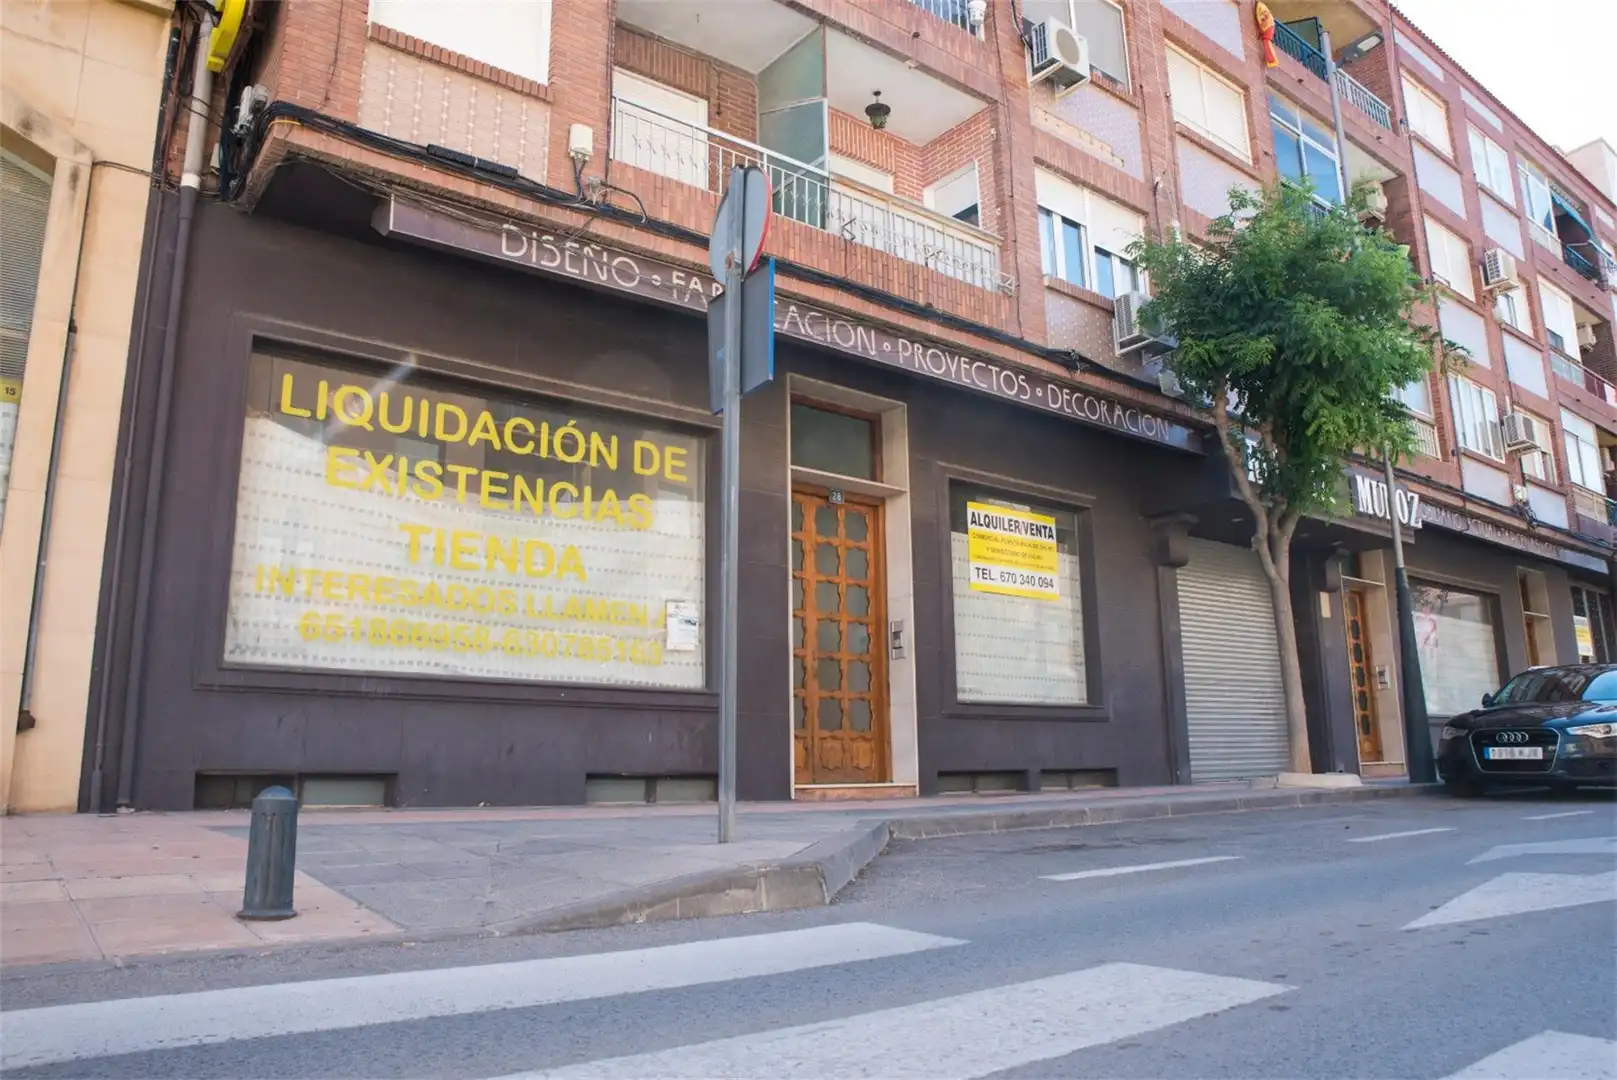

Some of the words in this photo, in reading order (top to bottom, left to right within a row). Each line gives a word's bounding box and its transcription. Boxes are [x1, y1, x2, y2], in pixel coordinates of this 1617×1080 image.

[501, 224, 640, 288] DISEÑO
[899, 338, 1031, 400] PROYECTOS
[1047, 384, 1170, 441] DECORACION
[279, 373, 619, 471] LIQUIDACIÓN
[632, 440, 689, 482] DE
[325, 446, 654, 530] EXISTENCIAS
[400, 523, 587, 582] TIENDA
[969, 511, 1055, 540] ALQUILER/VENTA
[254, 563, 517, 616] INTERESADOS
[525, 593, 648, 628] LLAMEN
[999, 571, 1017, 584] 670
[1019, 574, 1036, 586] 340
[1037, 576, 1054, 588] 094
